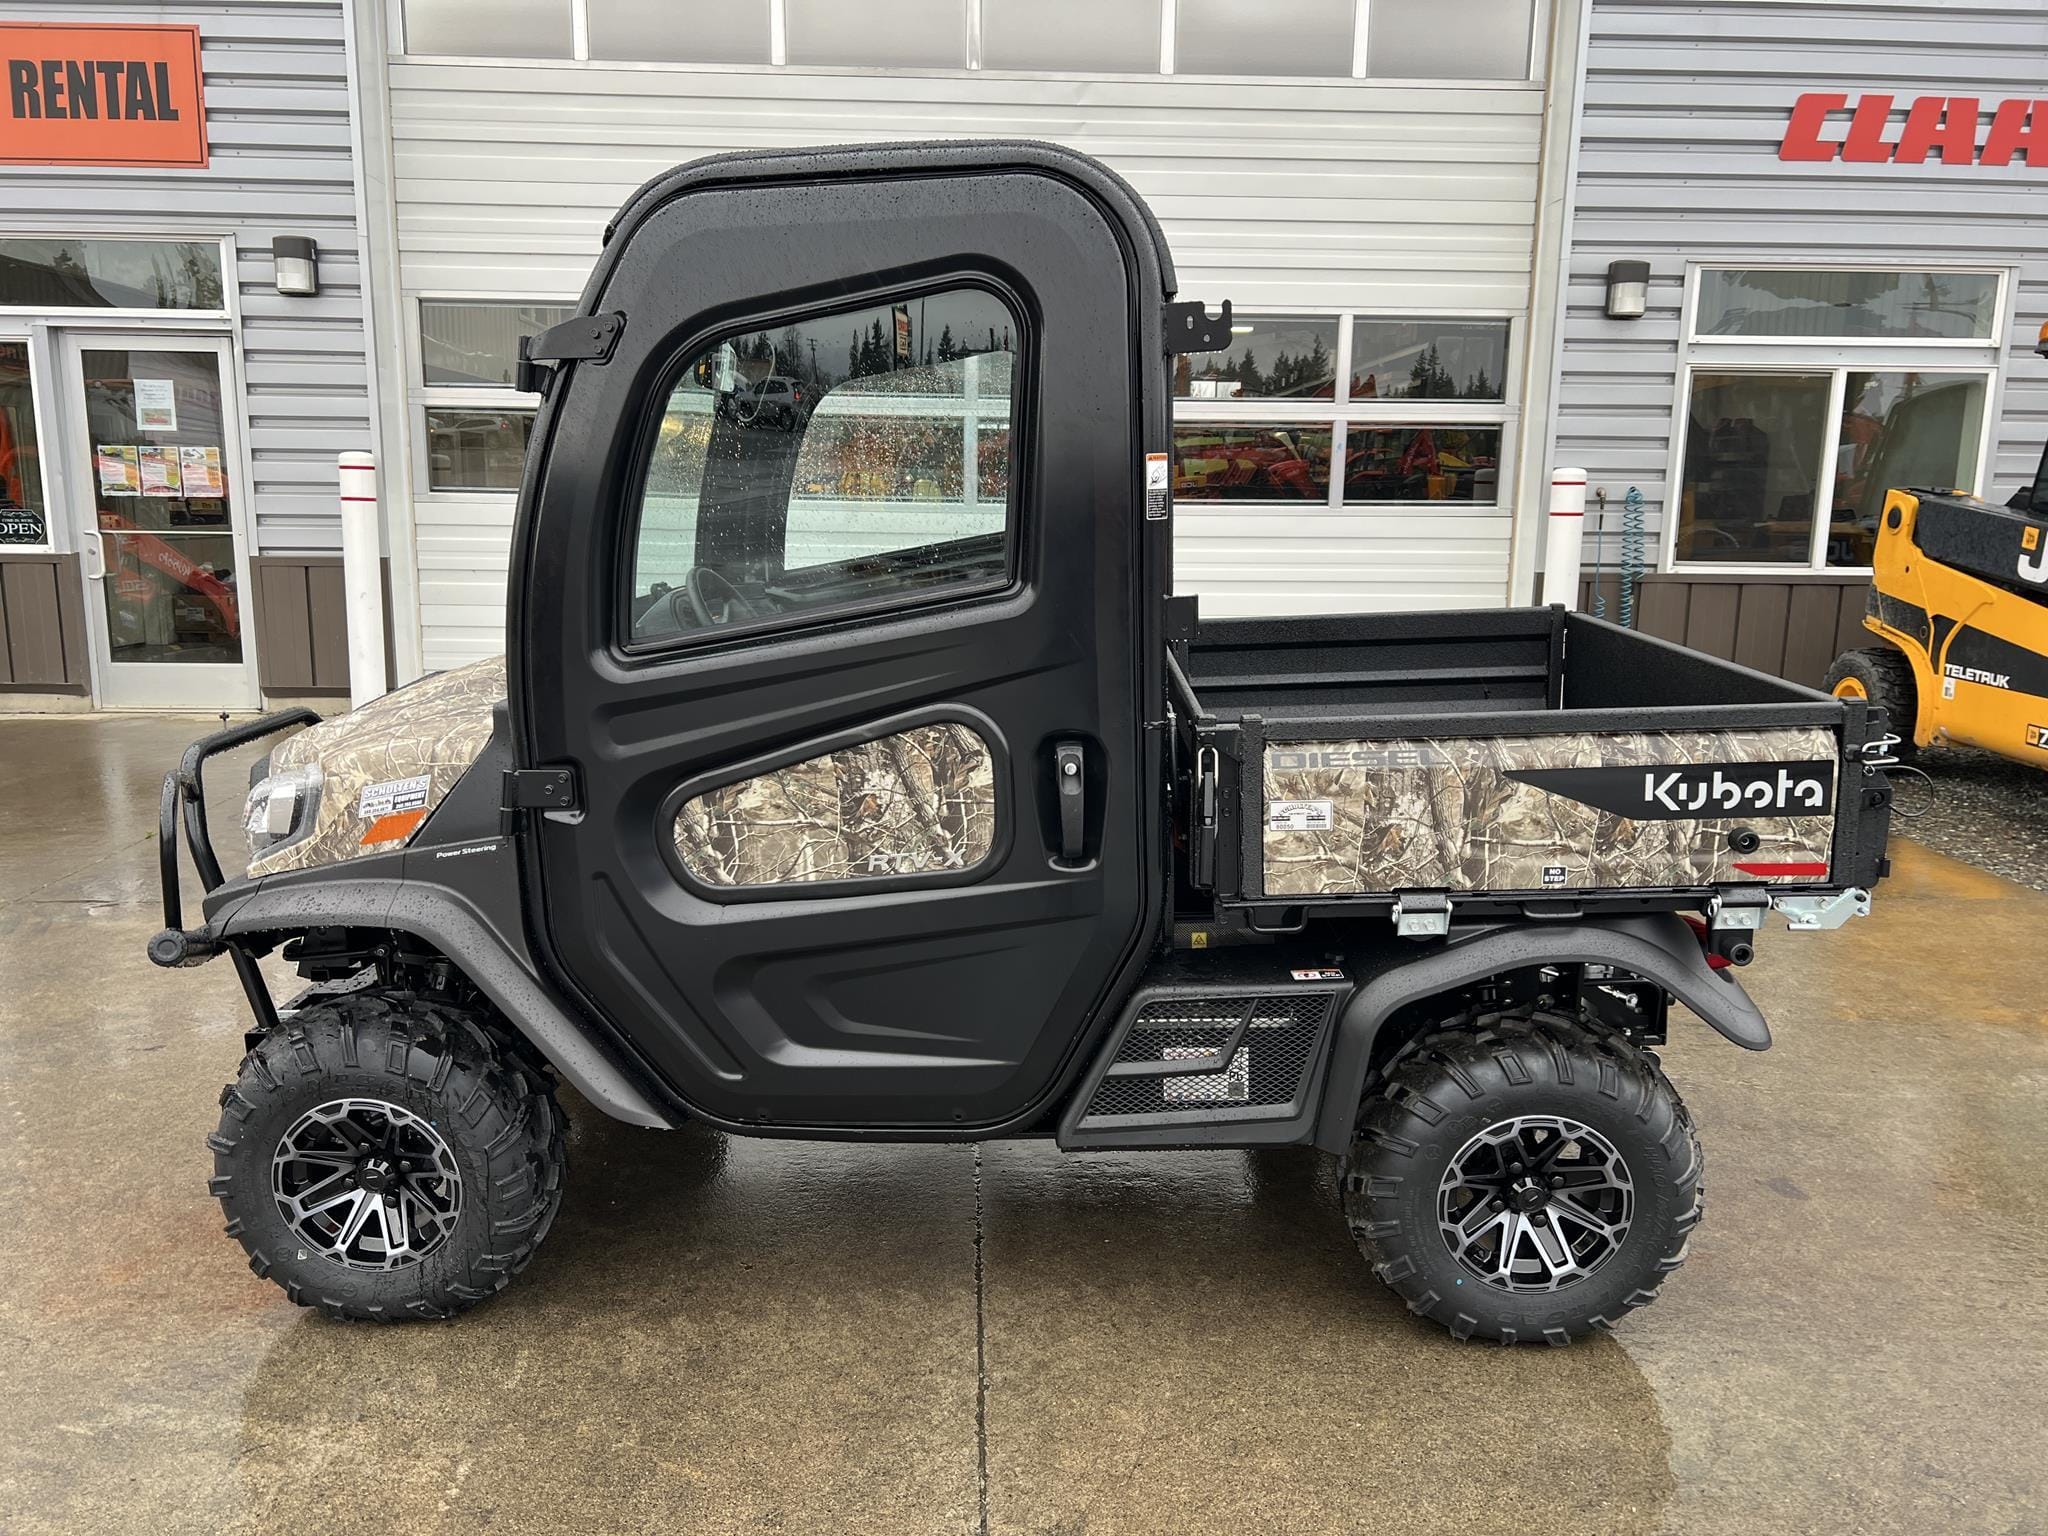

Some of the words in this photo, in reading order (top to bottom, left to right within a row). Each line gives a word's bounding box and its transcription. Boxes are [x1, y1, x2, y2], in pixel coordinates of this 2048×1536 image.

[8, 59, 180, 121] RENTAL
[1778, 93, 2048, 167] CLAA
[0, 522, 42, 535] OPEN
[1944, 663, 2011, 688] TELETRUK
[1272, 750, 1436, 768] DIESEL
[1644, 769, 1824, 811] Kubota
[436, 849, 461, 859] Power
[461, 844, 497, 855] Steering
[867, 848, 967, 872] RTV-X
